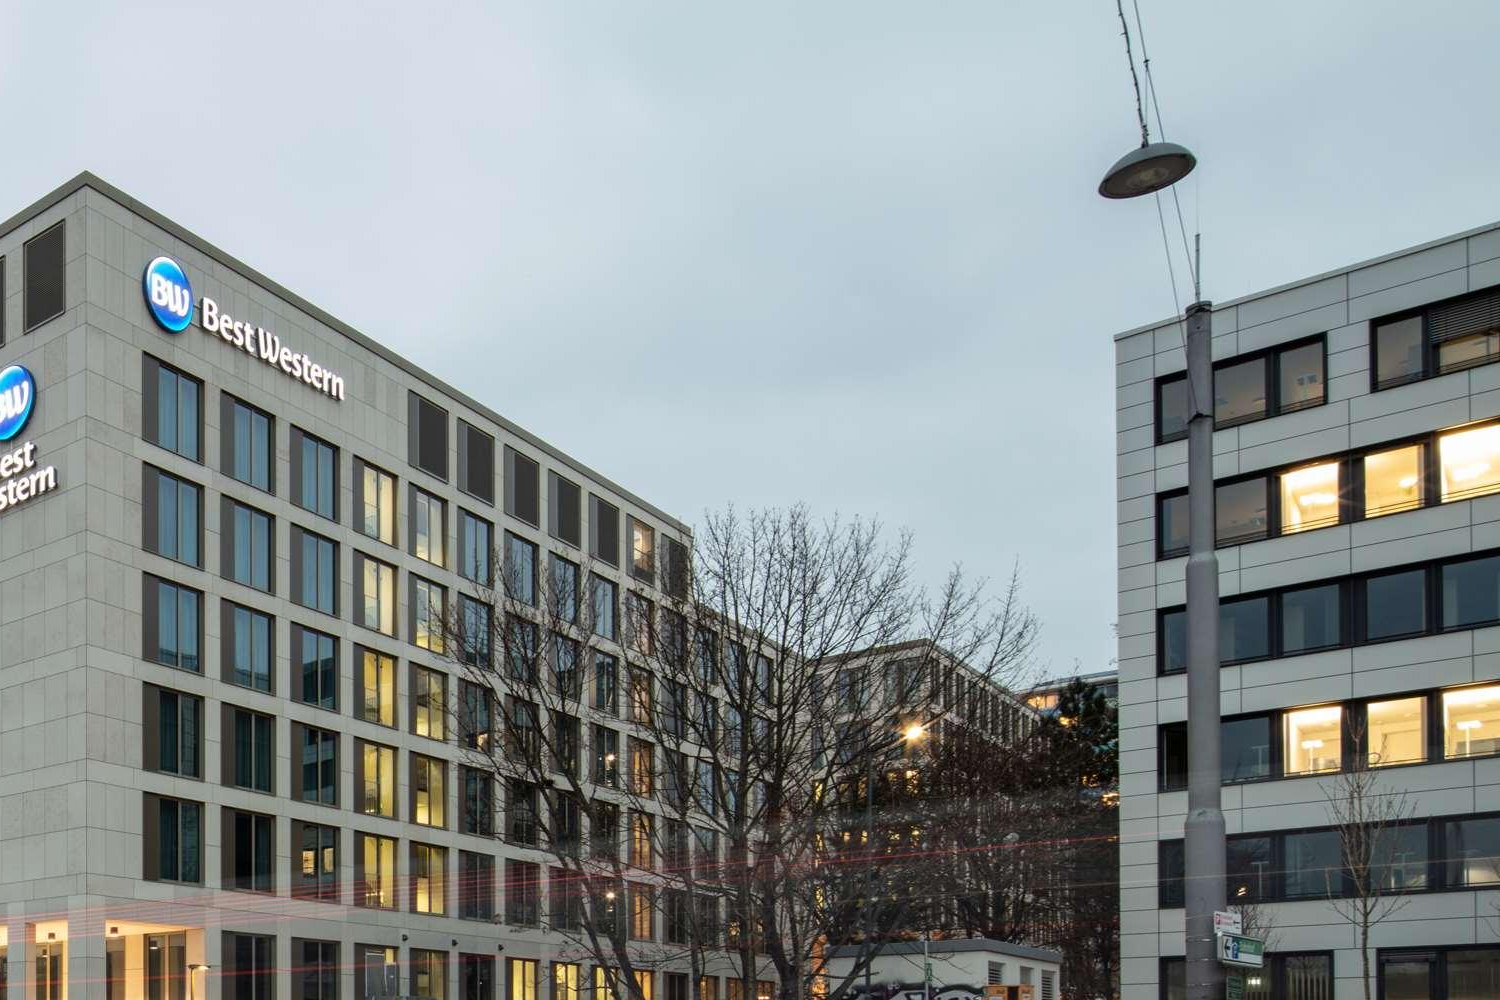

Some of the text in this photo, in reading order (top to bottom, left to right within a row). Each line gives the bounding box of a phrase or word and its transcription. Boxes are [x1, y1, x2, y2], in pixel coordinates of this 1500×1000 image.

[151, 271, 190, 318] BW
[201, 296, 345, 401] Best Western
